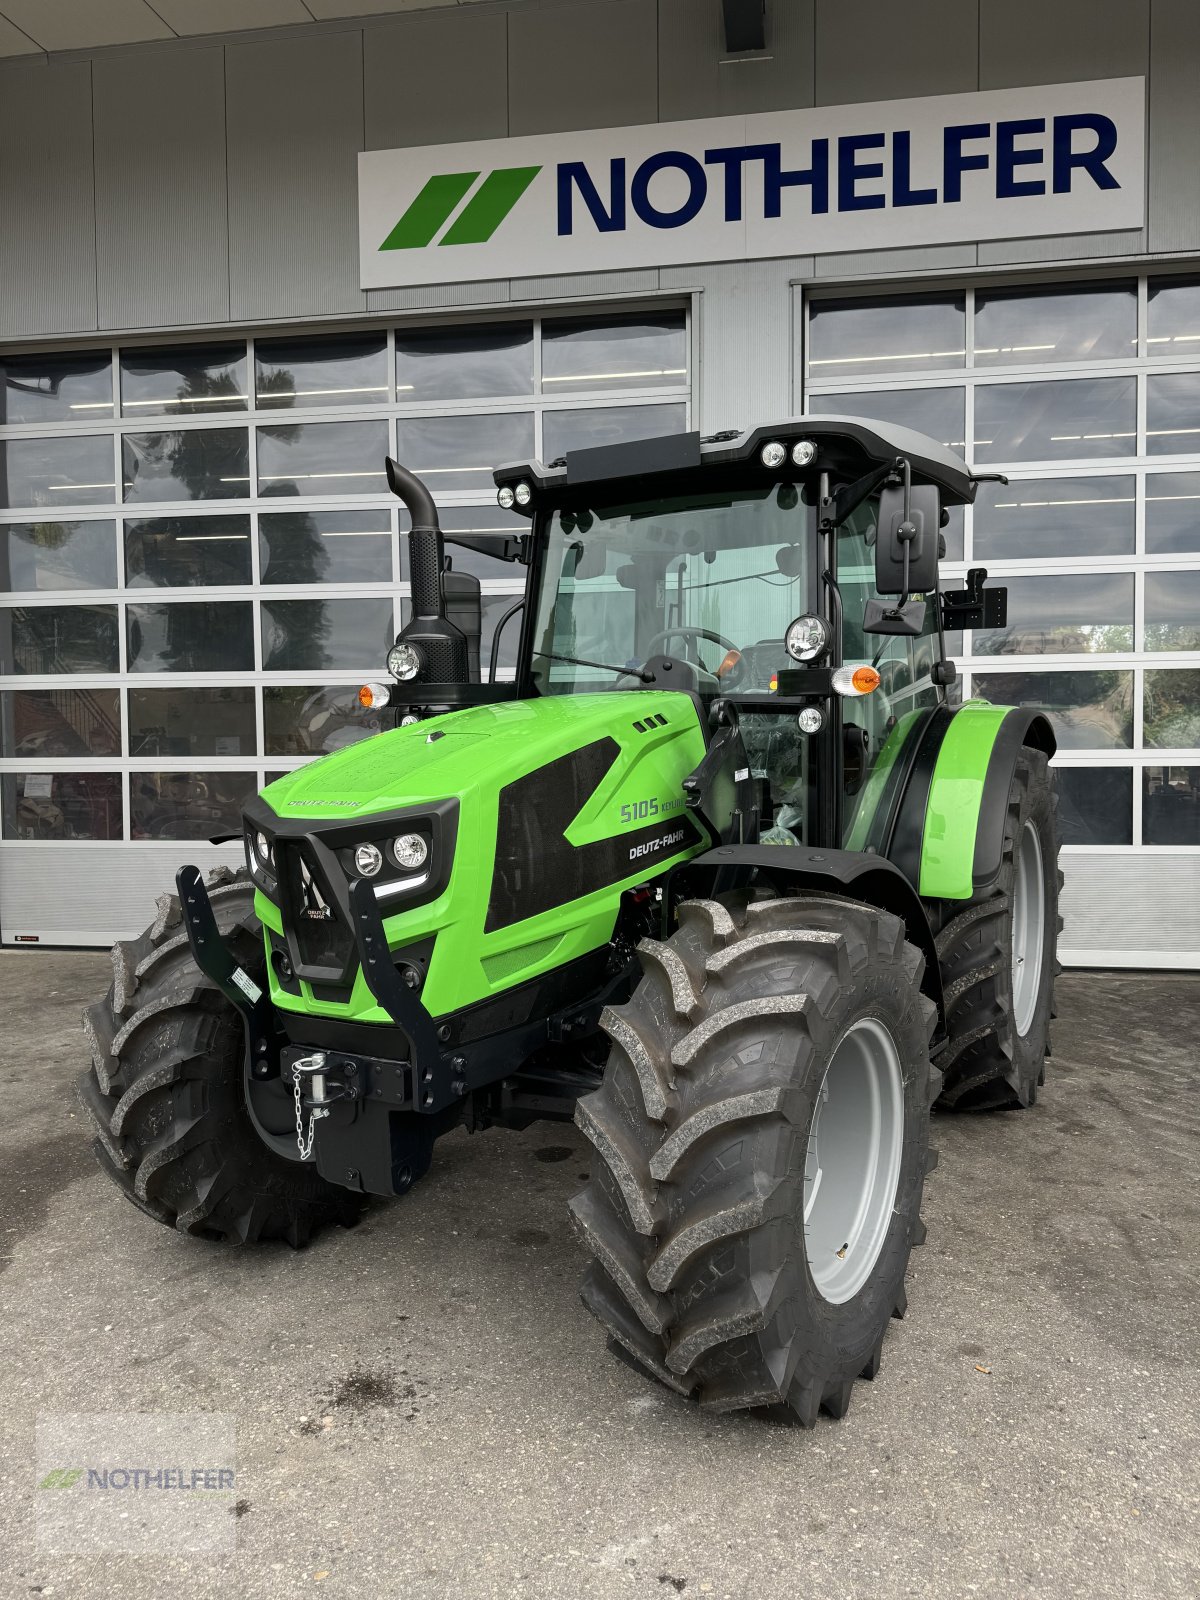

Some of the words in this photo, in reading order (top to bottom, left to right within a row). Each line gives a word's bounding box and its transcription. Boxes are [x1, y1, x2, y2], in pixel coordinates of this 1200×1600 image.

[557, 113, 1122, 236] NOTHELFER
[620, 797, 659, 823] 5105
[629, 829, 684, 860] DEUTZ-FAHR
